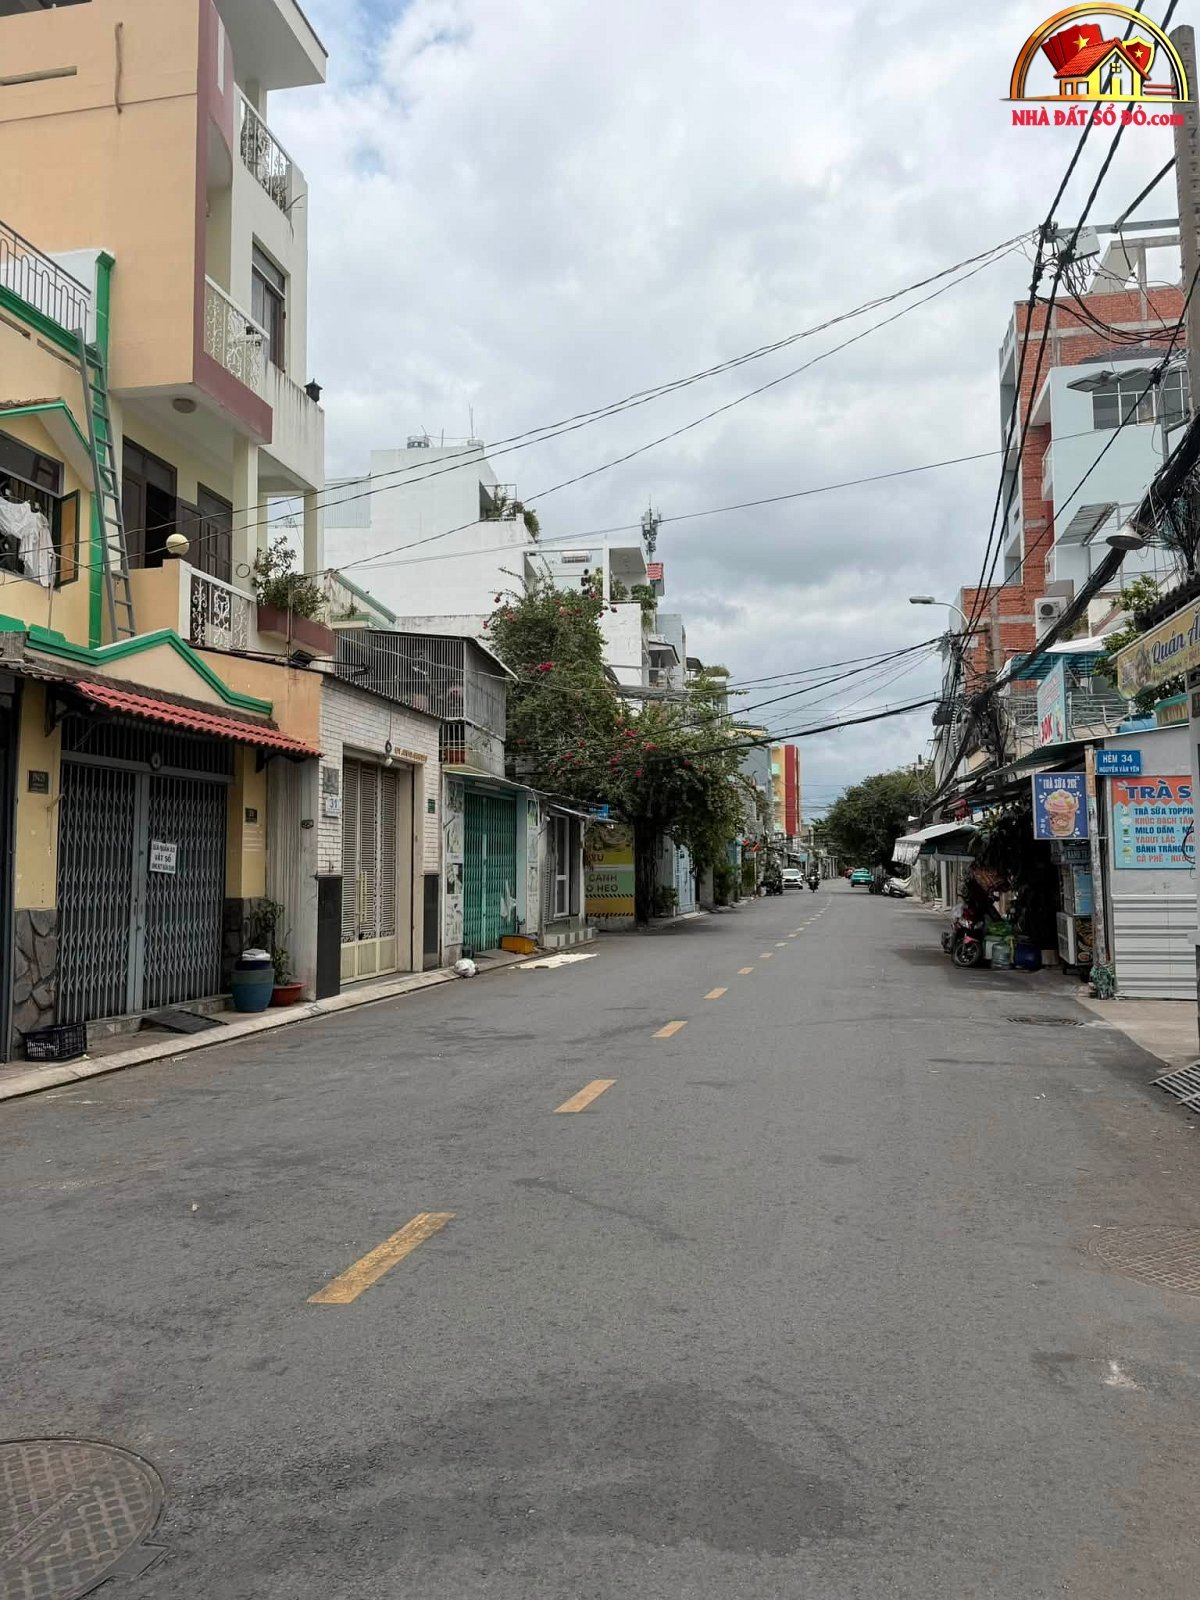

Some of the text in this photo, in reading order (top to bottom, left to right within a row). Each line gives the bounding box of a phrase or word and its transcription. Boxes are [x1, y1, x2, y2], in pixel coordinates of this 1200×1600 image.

[1151, 630, 1185, 664] Quán
[1103, 751, 1133, 763] HẺM 34
[1125, 779, 1173, 799] TRÀ
[1134, 806, 1149, 815] TRÀ
[1151, 805, 1166, 815] SỮA
[1135, 826, 1155, 834] MILO
[1136, 844, 1157, 853] BÁNH
